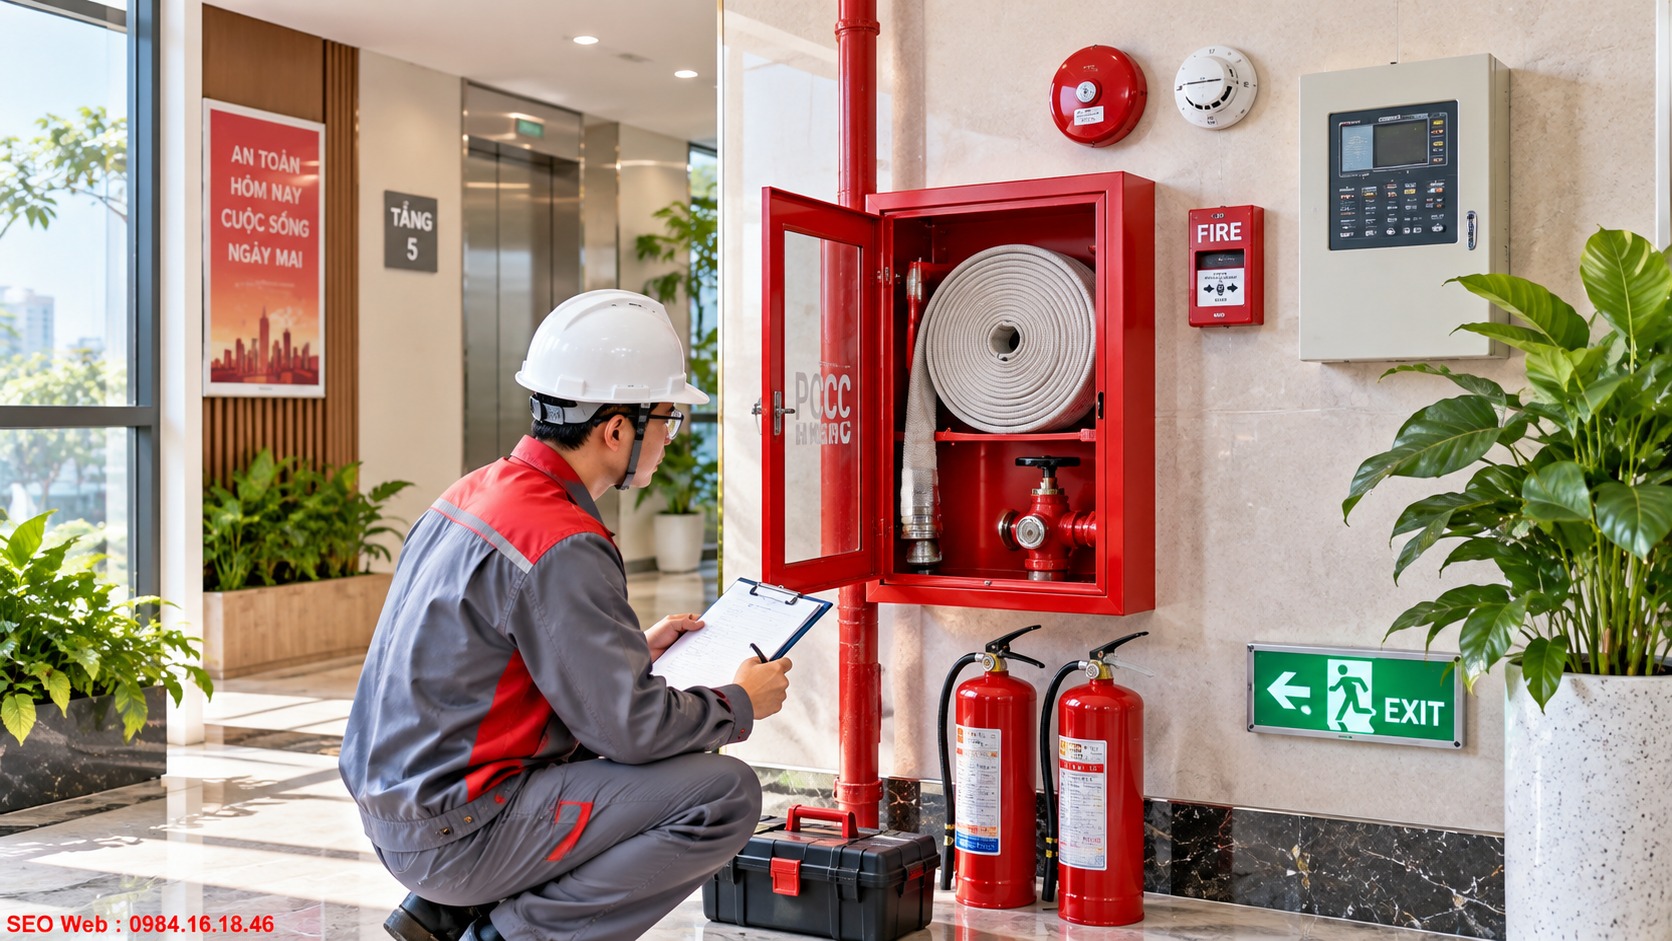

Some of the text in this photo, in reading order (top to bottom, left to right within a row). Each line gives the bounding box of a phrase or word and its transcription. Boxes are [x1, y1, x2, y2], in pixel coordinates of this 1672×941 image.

[231, 145, 254, 166] AN
[271, 183, 303, 205] NAY
[1197, 222, 1243, 243] FIRE
[275, 248, 303, 269] MAI
[406, 236, 419, 262] 5
[1385, 697, 1445, 727] EXIT
